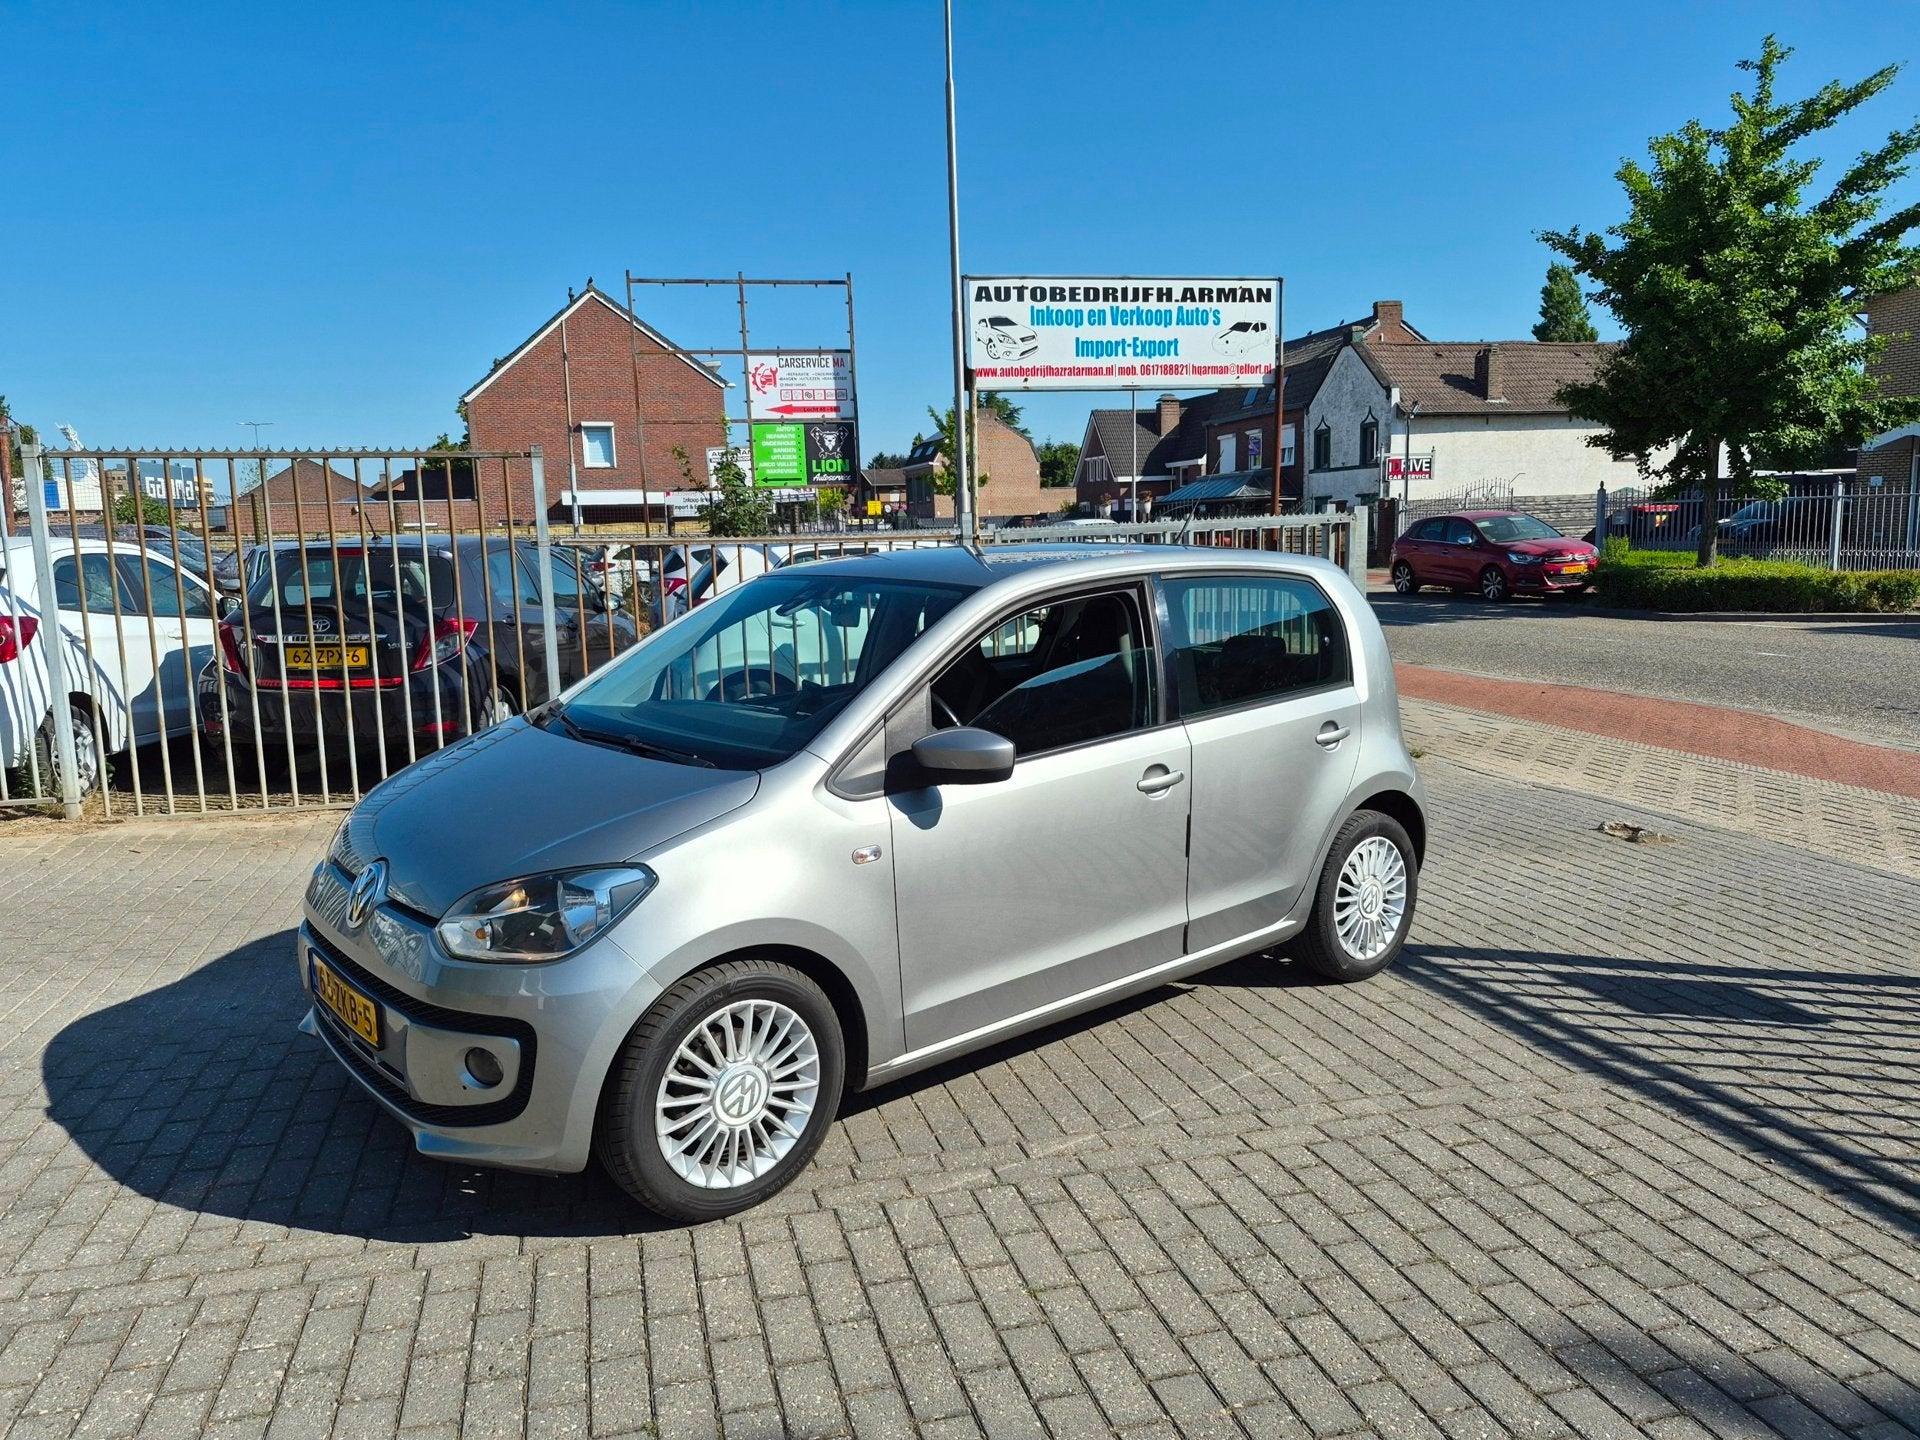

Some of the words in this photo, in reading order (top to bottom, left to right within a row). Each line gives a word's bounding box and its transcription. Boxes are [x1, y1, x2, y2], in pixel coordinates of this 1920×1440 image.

[1030, 305, 1084, 327] Inkoop
[1087, 308, 1106, 326] en
[1110, 305, 1173, 328] Verkoop
[1176, 305, 1221, 326] Auto's
[1075, 336, 1179, 359] Import-Export
[778, 357, 830, 369] CARSERVICE
[833, 357, 845, 368] MA
[812, 459, 850, 473] LION
